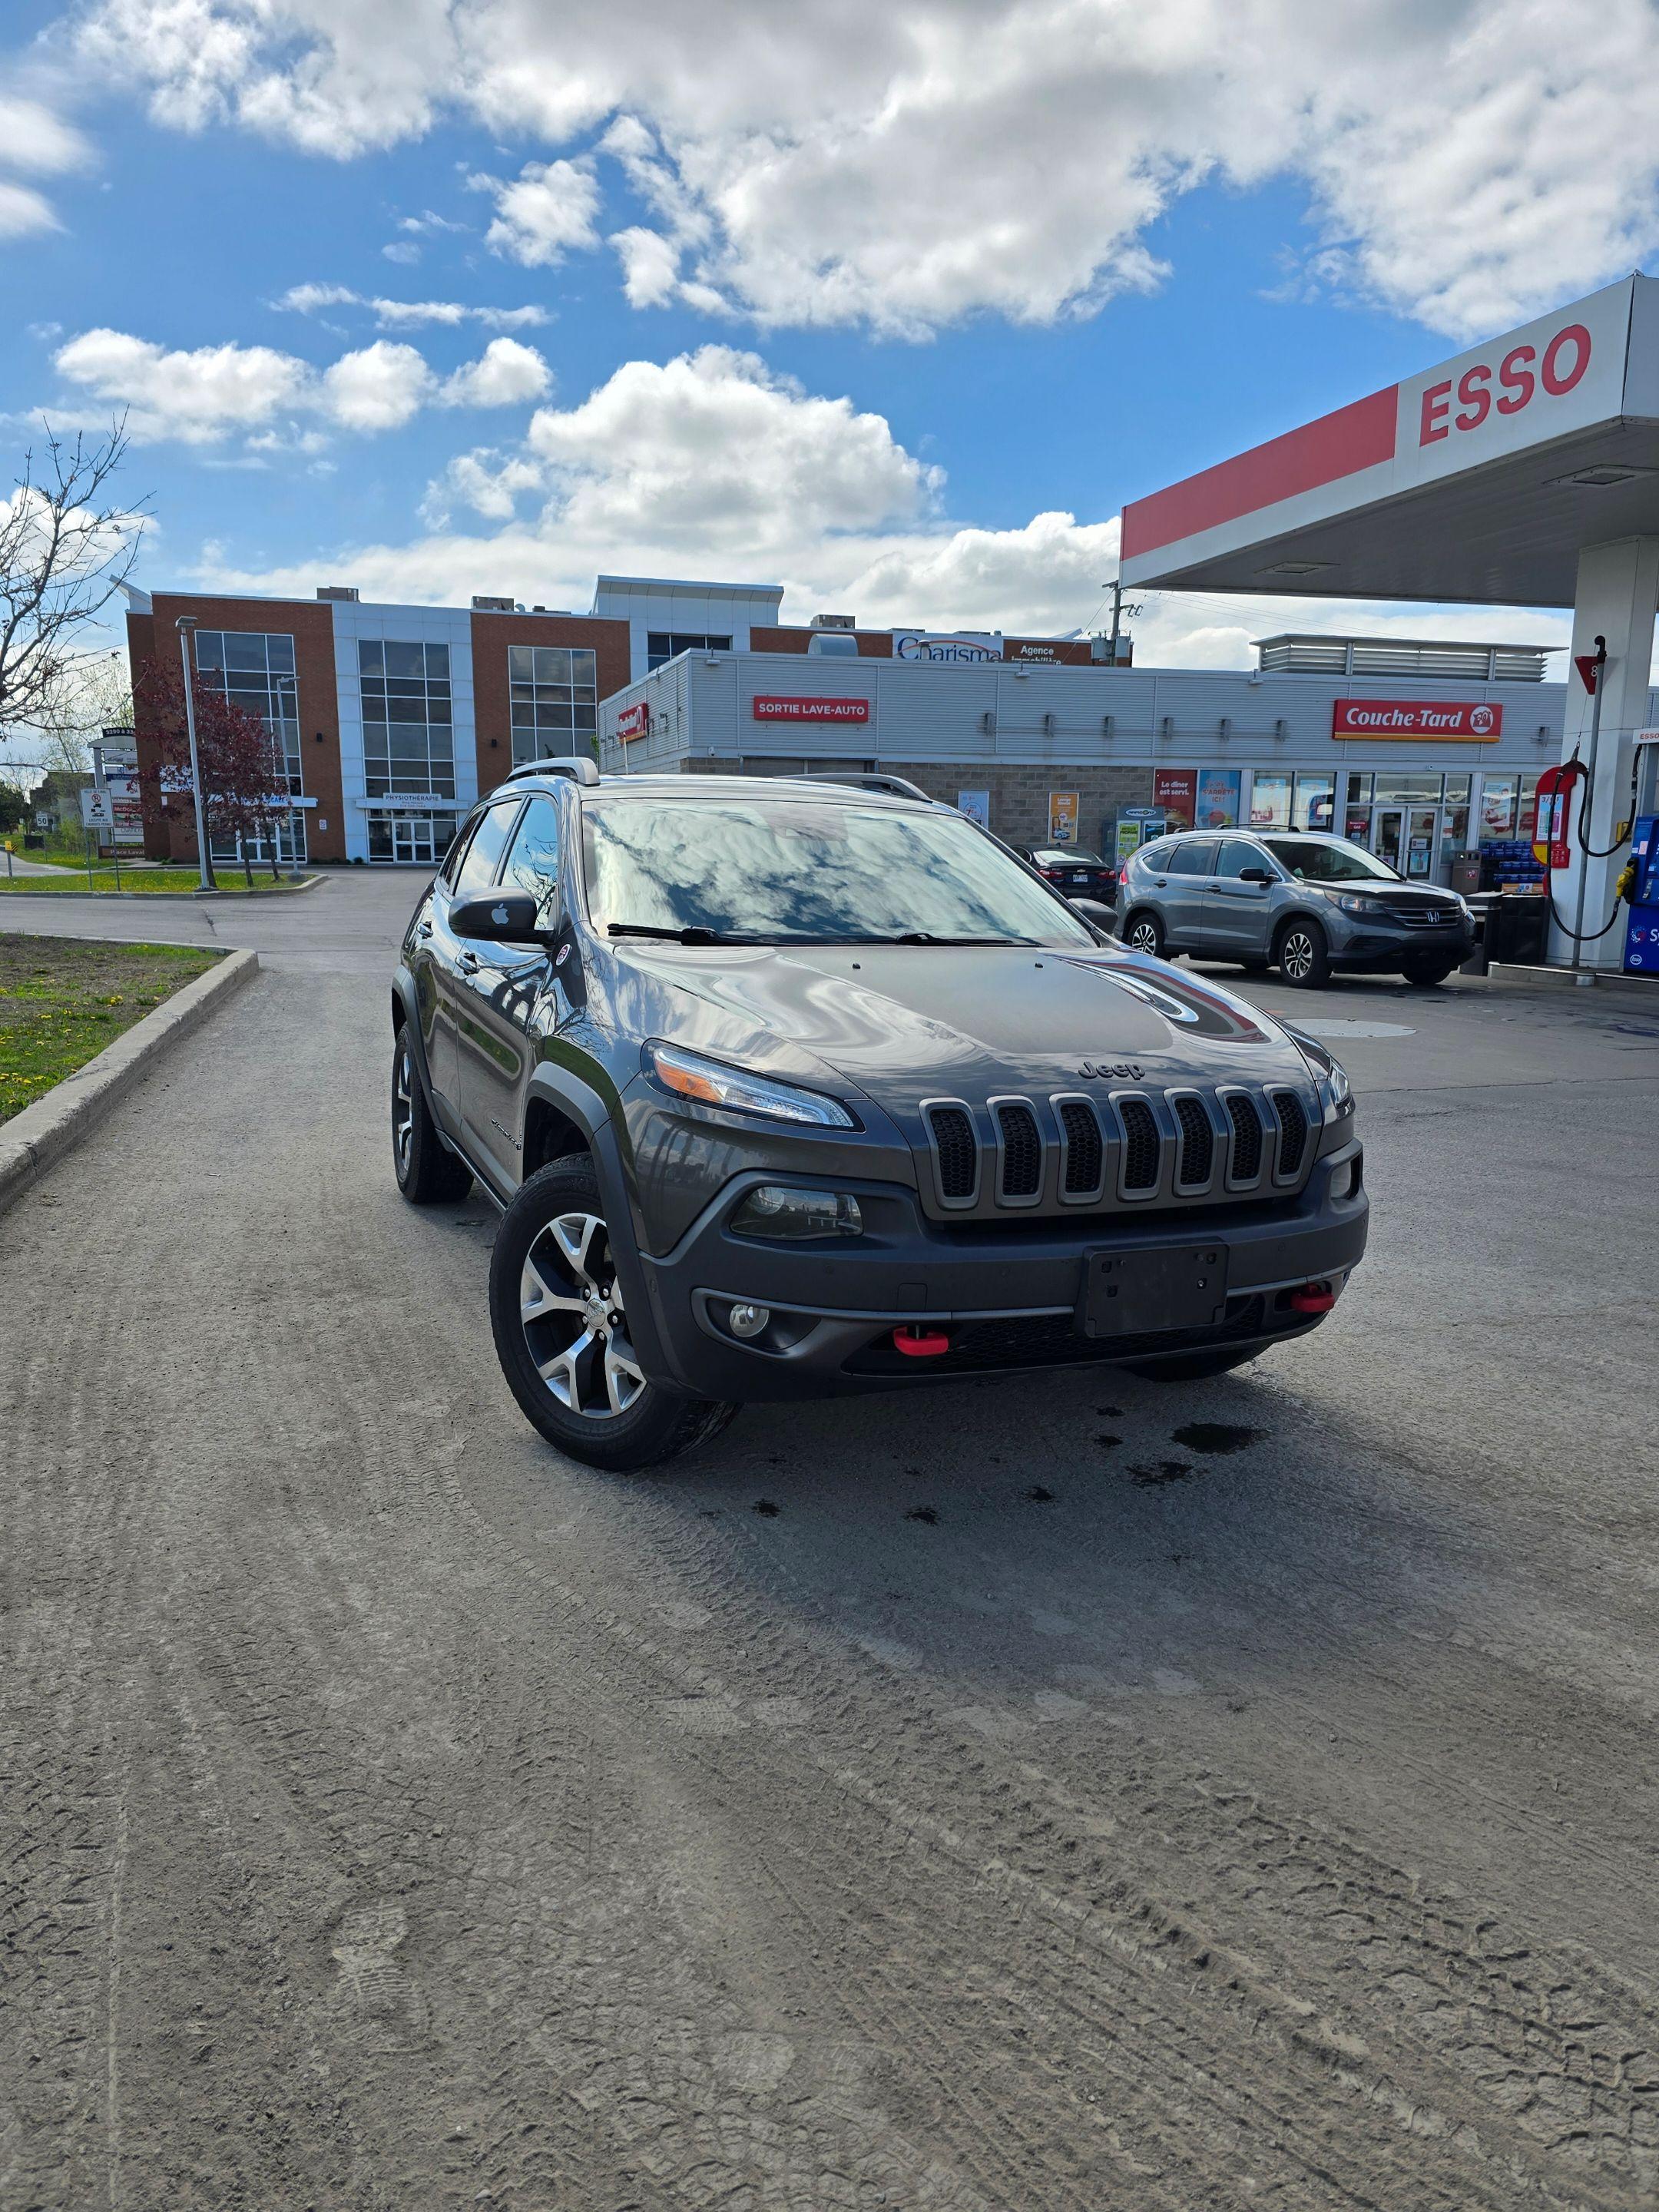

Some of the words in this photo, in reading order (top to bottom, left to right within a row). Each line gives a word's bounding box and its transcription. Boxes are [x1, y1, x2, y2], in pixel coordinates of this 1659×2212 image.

[1419, 323, 1591, 448] ESSO
[1020, 645, 1055, 656] Agence
[1591, 665, 1598, 677] 8
[759, 704, 800, 714] SORTIE
[803, 704, 865, 715] LAVE-AUTO
[1346, 707, 1463, 727] Couche-Tard
[1078, 1061, 1146, 1080] Jeep
